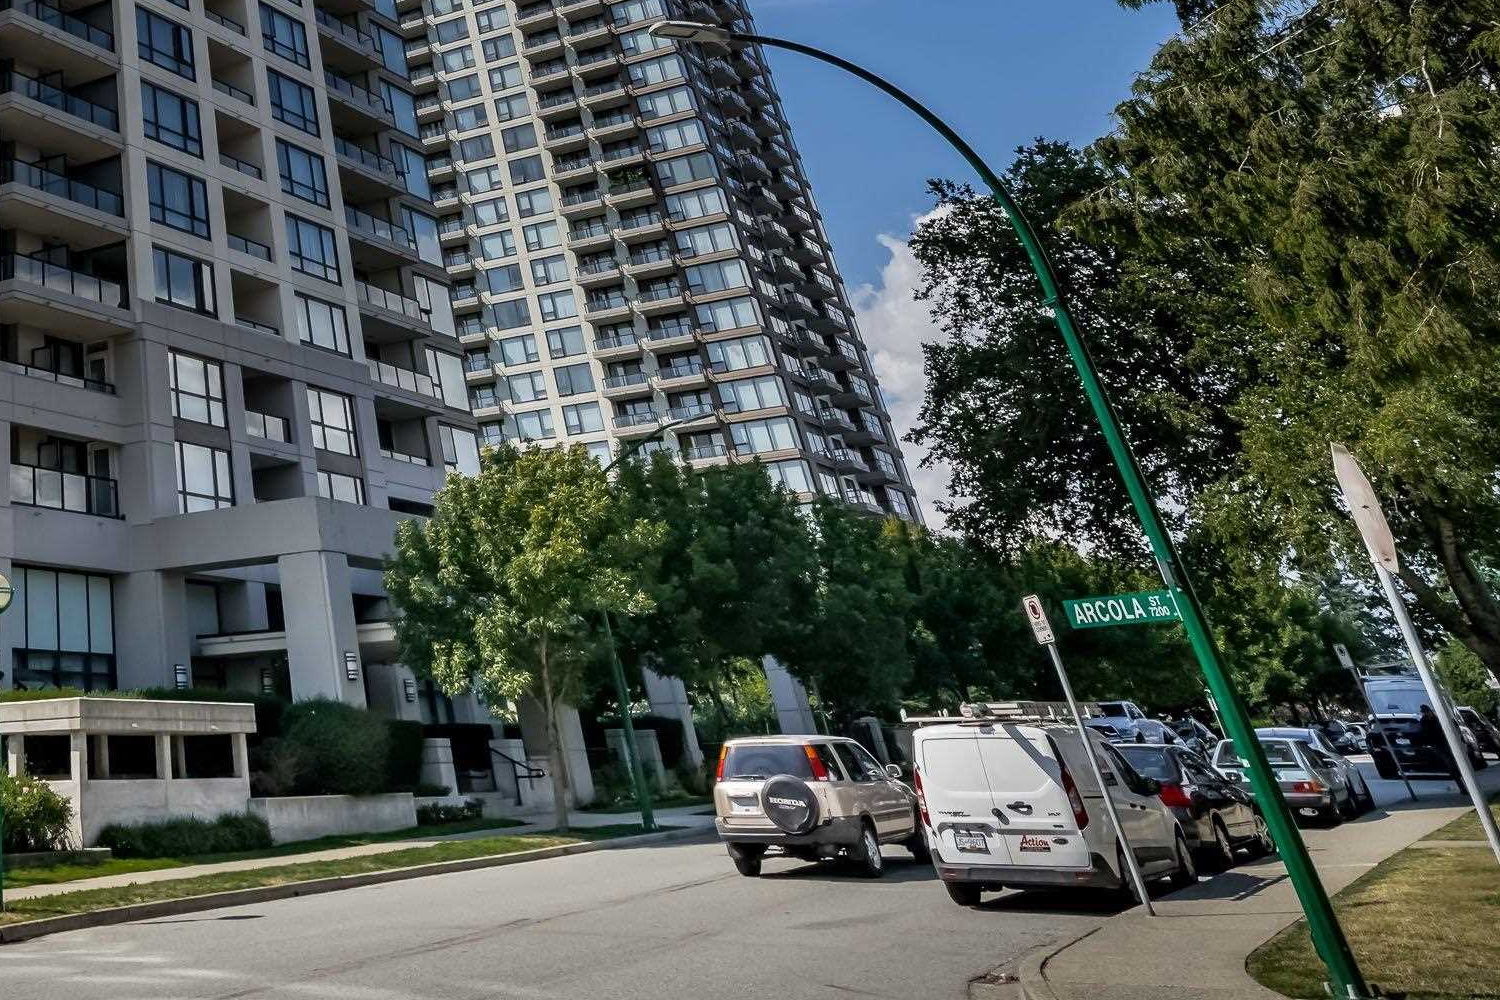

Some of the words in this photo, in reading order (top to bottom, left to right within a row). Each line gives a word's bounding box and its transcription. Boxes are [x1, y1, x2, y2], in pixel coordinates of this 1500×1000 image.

[1073, 598, 1147, 624] ARCOLA
[1148, 596, 1160, 607] ST
[1148, 606, 1170, 617] 7200
[769, 797, 807, 808] HONDA
[1020, 835, 1050, 847] Action
